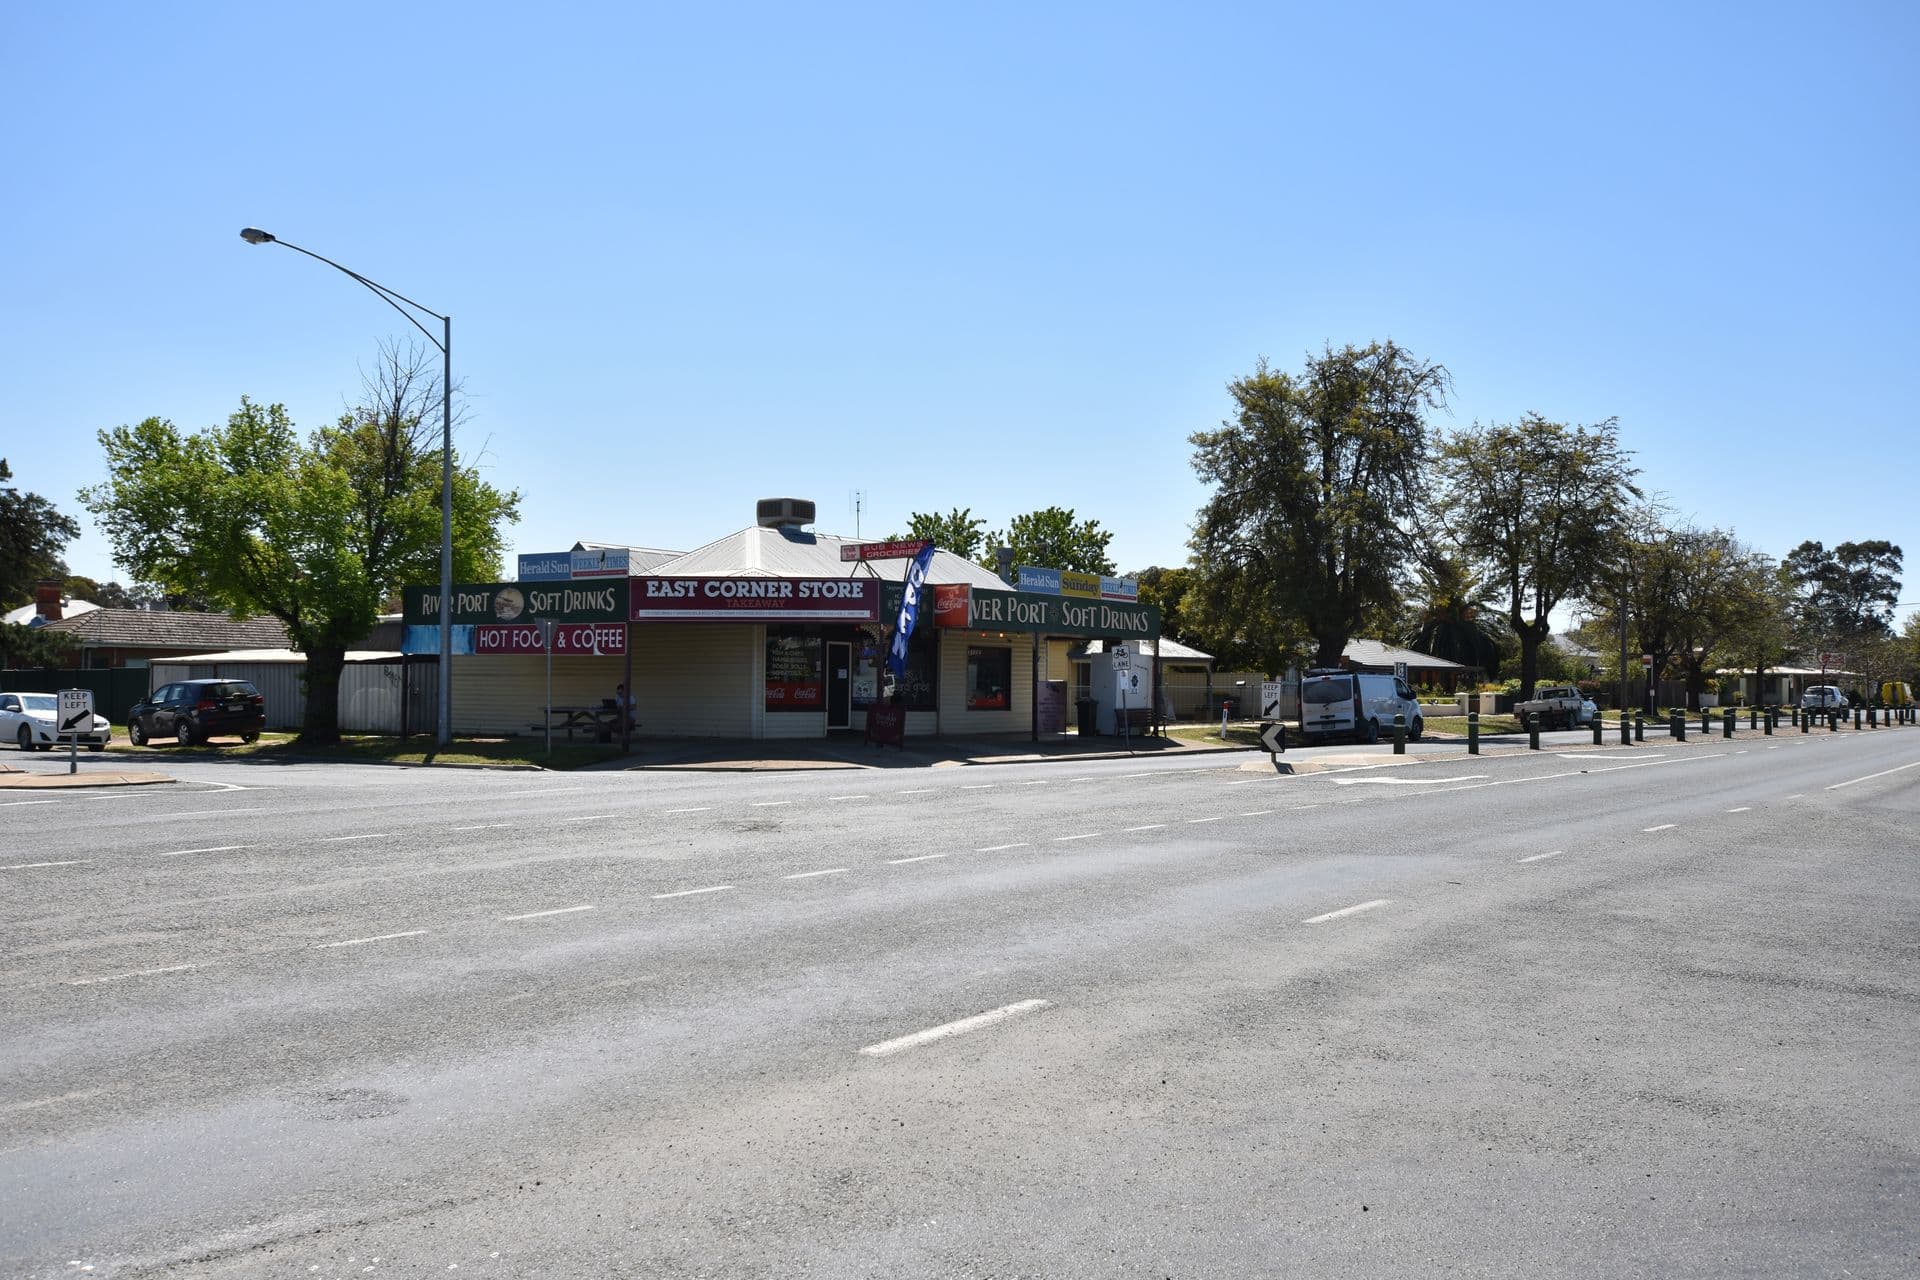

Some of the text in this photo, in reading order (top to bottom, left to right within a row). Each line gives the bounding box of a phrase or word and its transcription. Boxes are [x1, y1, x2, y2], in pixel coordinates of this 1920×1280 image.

[520, 560, 549, 575] Herald
[550, 560, 569, 574] Sun
[1020, 572, 1059, 588] Herald Sun
[1062, 577, 1099, 596] Sunday
[646, 581, 864, 598] EAST CORNER STORE
[422, 592, 490, 615] RIVR PORT
[529, 588, 615, 614] SOFT DRINKS
[727, 599, 785, 608] TAKEAWAY
[972, 597, 1049, 624] VER PORT
[1062, 601, 1149, 632] SOFT DRINKS
[480, 629, 623, 648] HOT FOO & COFFEE
[1113, 661, 1129, 669] LANE
[64, 692, 88, 700] KEEP
[1264, 691, 1279, 699] LEFT
[65, 701, 87, 709] LEFT
